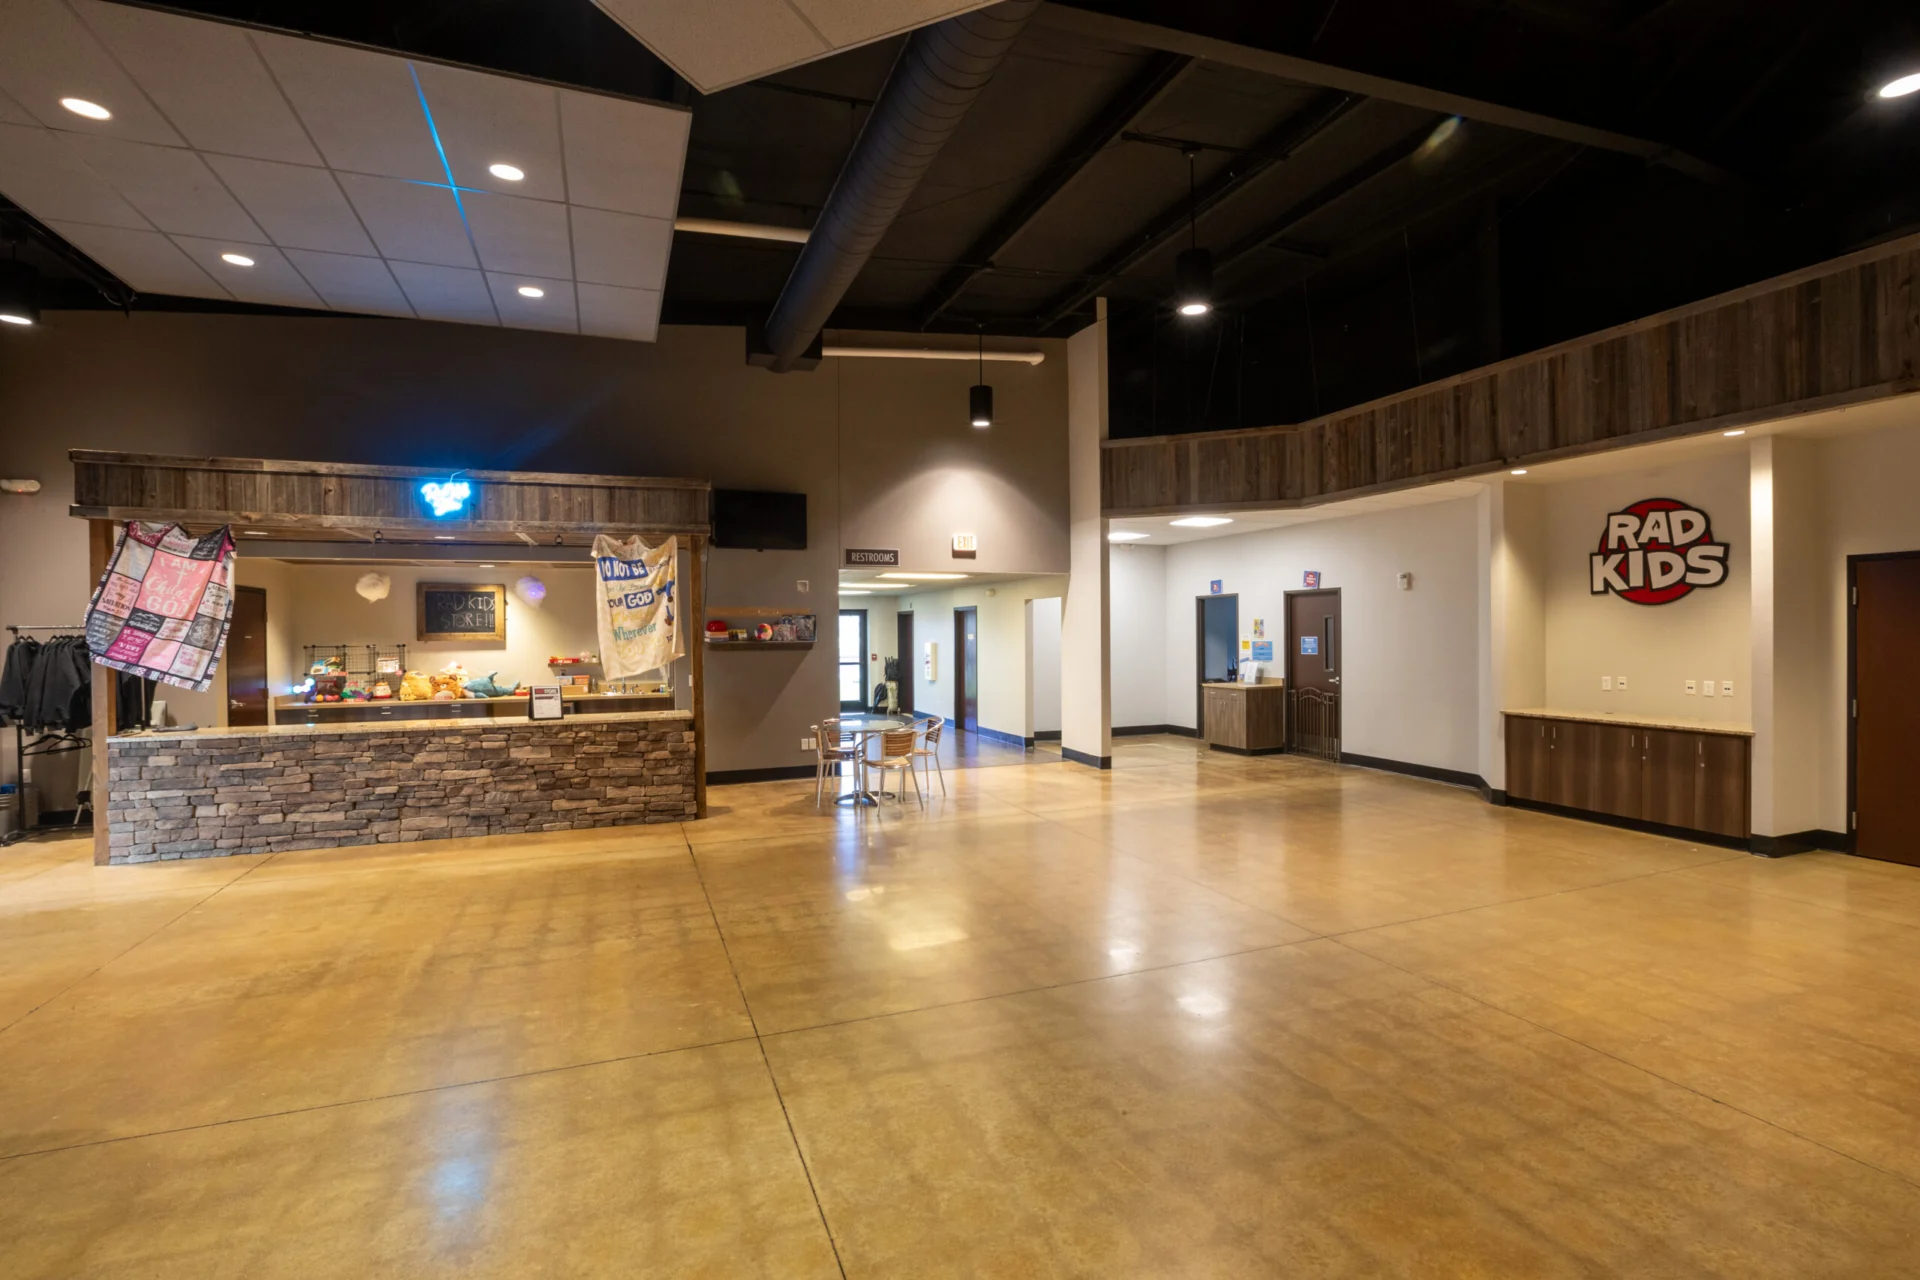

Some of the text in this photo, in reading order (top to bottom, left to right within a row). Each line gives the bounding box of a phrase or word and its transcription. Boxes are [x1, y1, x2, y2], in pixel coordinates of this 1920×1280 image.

[1607, 508, 1707, 550] RAD
[957, 535, 974, 549] EXIT
[171, 558, 198, 571] AM
[851, 552, 895, 563] RESTROOMS
[613, 560, 630, 577] NOT
[632, 562, 646, 577] BE
[1590, 543, 1727, 593] KIDS
[468, 594, 496, 612] KIDS
[627, 591, 653, 608] GOD
